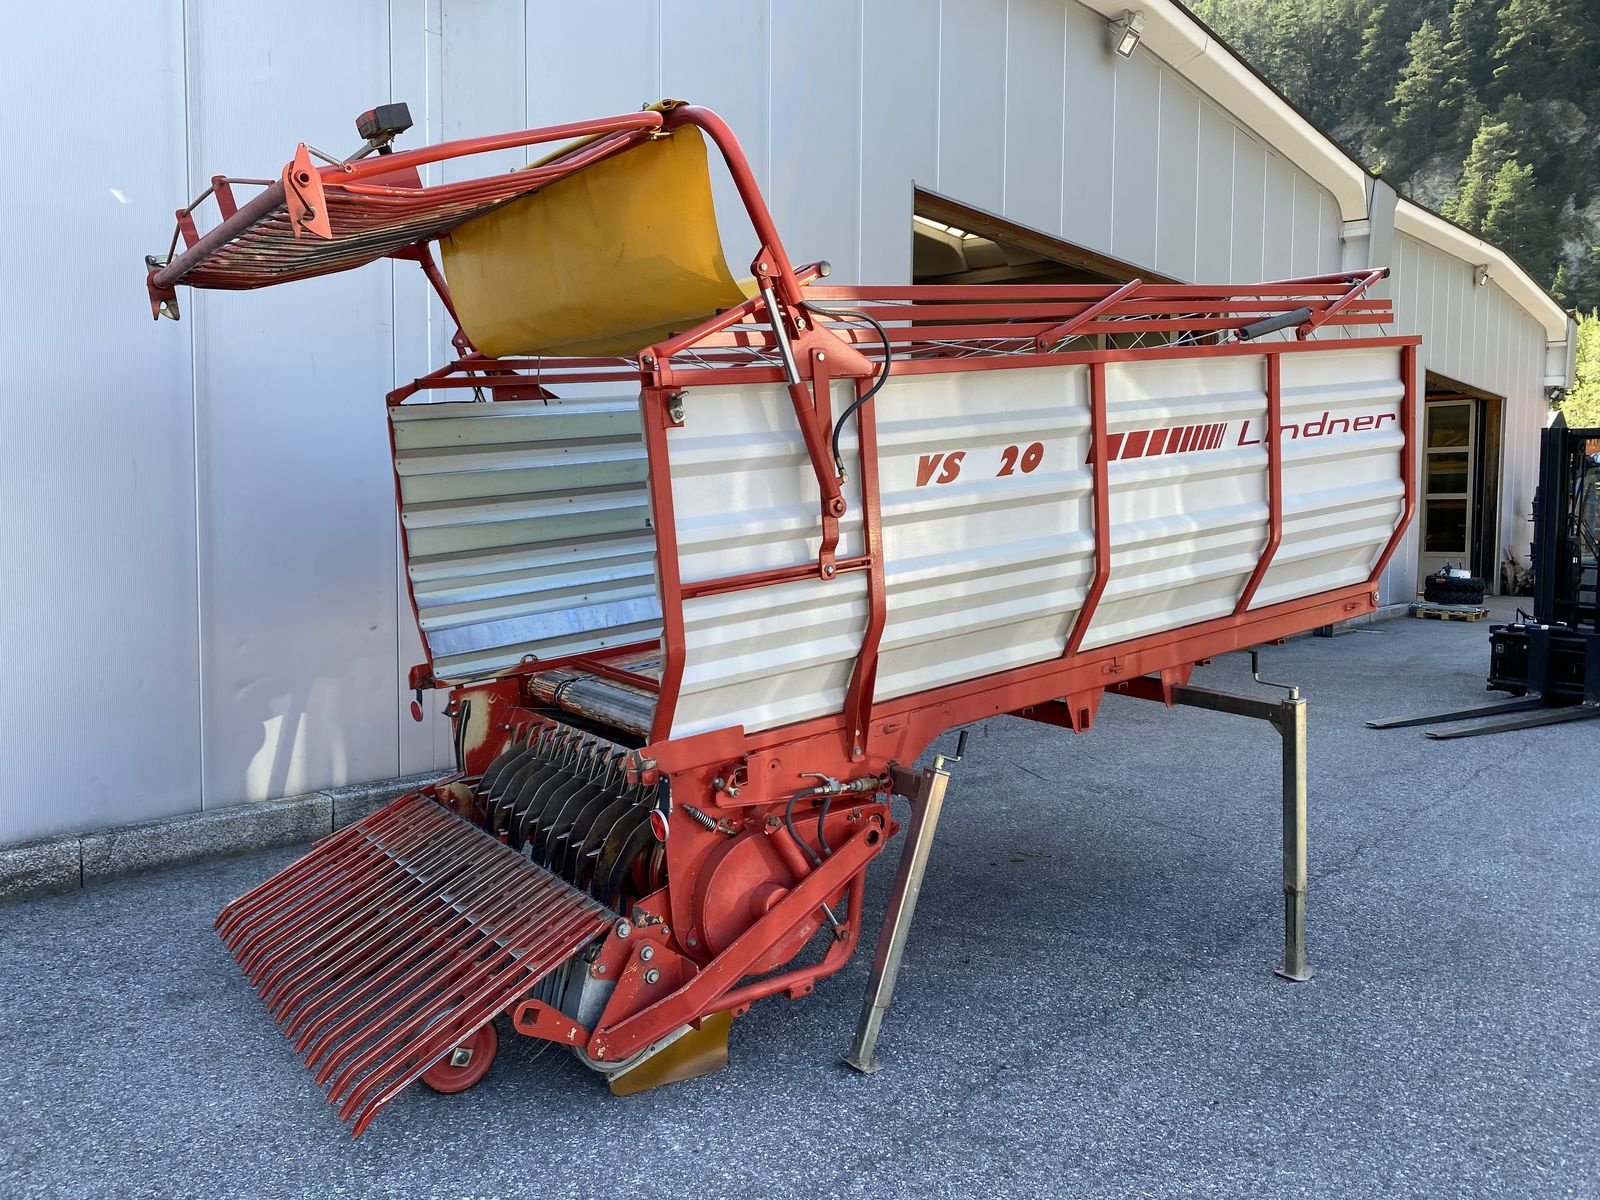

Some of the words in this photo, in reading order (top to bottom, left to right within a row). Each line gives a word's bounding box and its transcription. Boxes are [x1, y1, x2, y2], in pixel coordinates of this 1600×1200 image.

[1237, 411, 1396, 446] Lndner
[916, 451, 966, 487] VS
[996, 442, 1044, 477] 20
